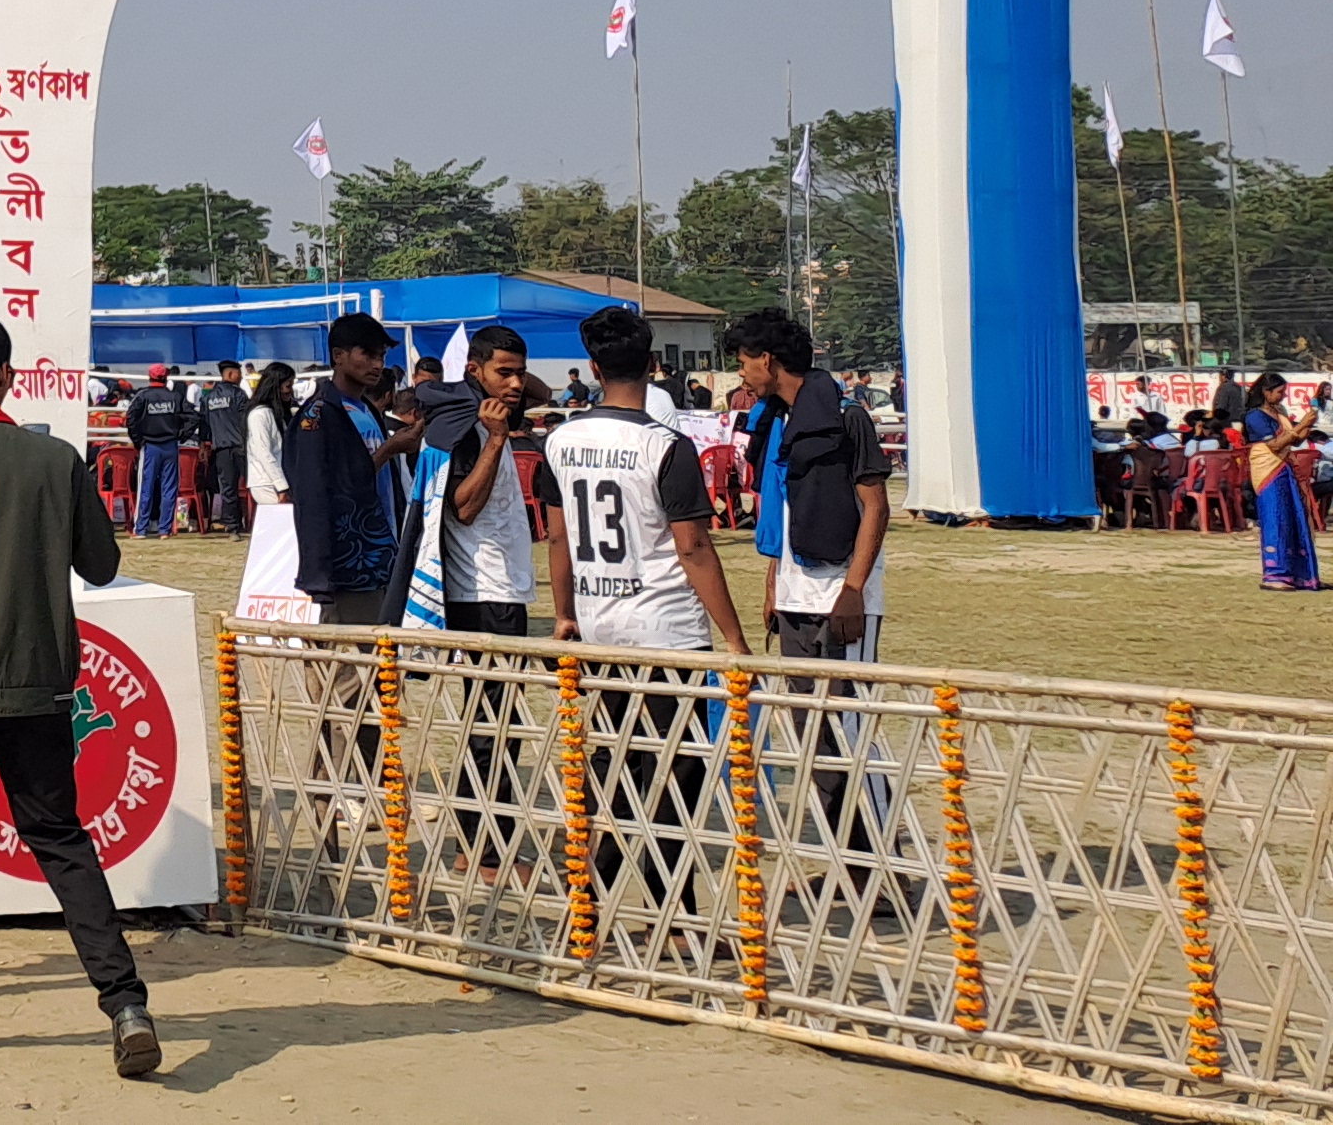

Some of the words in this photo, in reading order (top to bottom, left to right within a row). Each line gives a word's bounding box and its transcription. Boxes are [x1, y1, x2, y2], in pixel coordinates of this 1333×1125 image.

[11, 358, 85, 402] যোগিতা
[560, 447, 604, 468] MAJULI
[605, 448, 639, 470] AASU
[573, 479, 627, 564] 13
